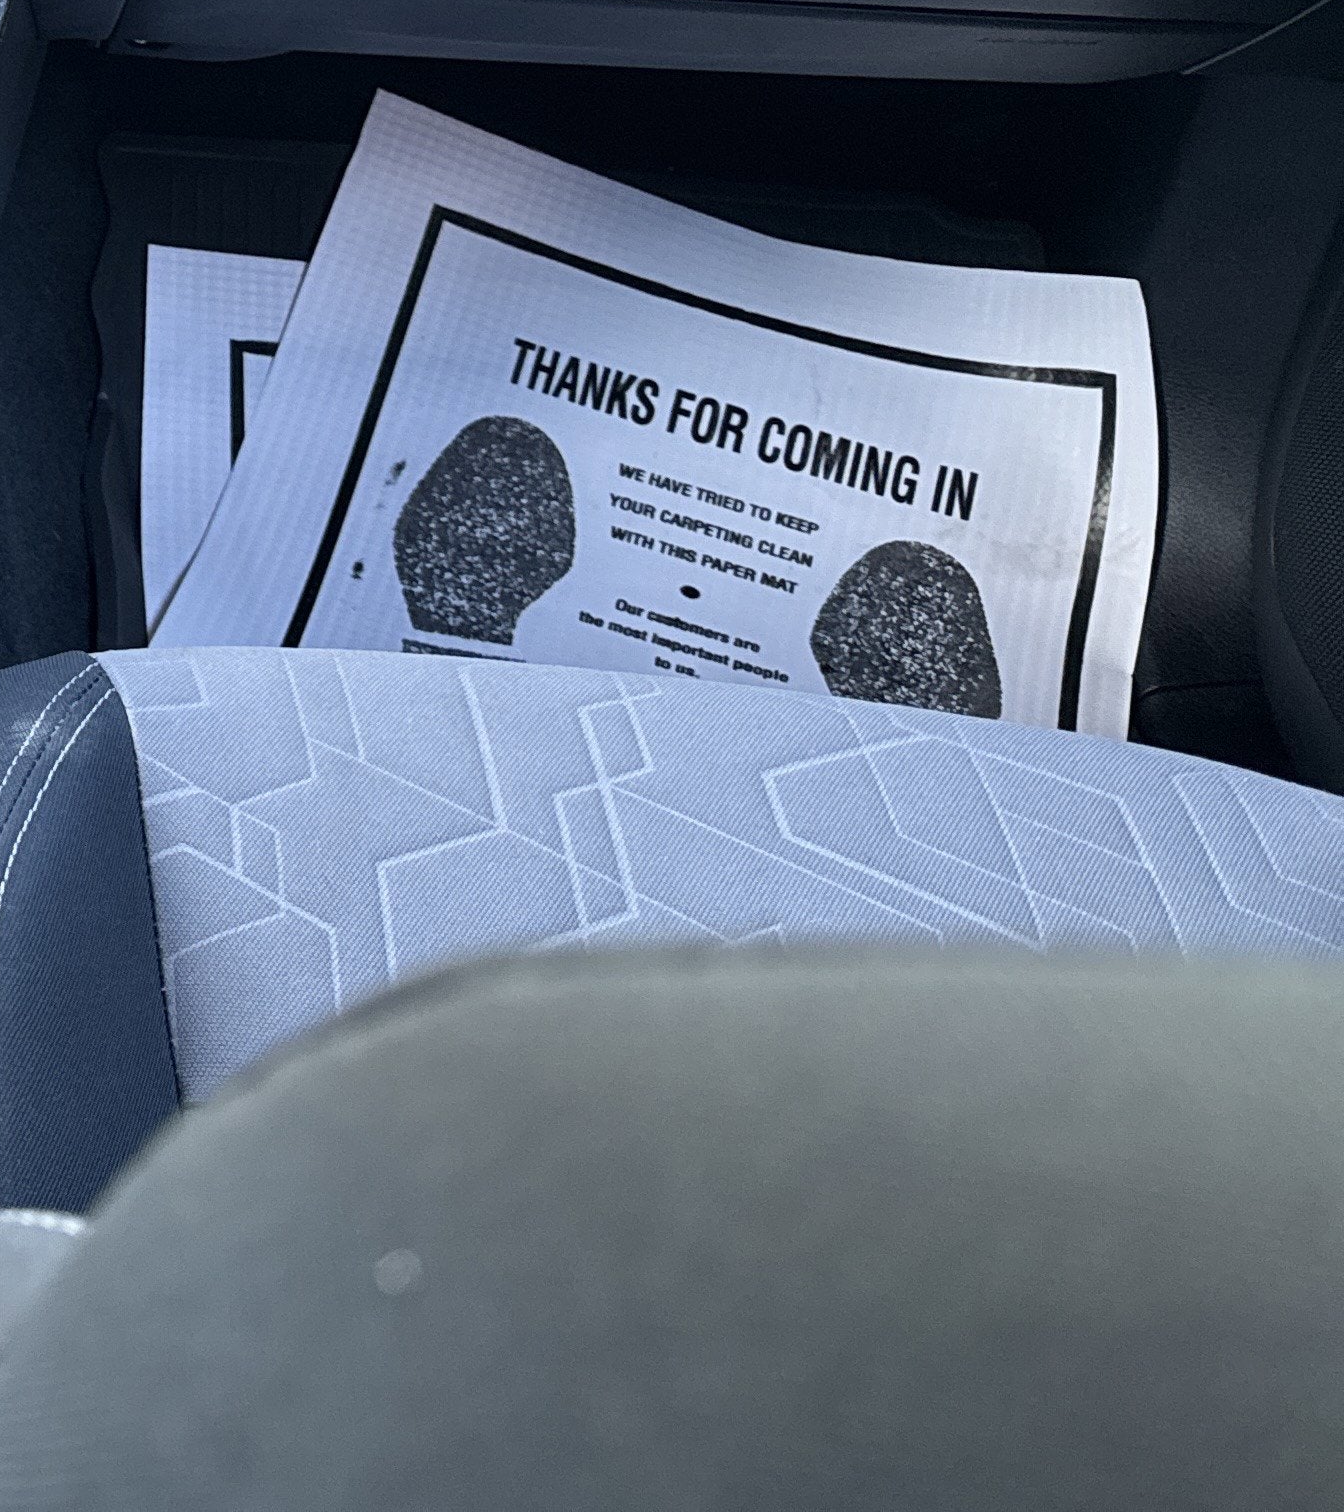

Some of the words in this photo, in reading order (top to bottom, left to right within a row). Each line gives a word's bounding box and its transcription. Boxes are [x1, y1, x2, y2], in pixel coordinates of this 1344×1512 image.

[510, 337, 660, 426] THANKS
[667, 389, 750, 453] FOR
[758, 416, 921, 506] COMING
[930, 465, 979, 522] IN
[610, 492, 657, 519] YOUR
[659, 510, 754, 549] CARPETING
[758, 540, 814, 567] CLEAN
[618, 462, 646, 483] WE
[648, 472, 693, 497] HAVE
[696, 486, 745, 514] TRIED
[749, 503, 773, 522] TO
[775, 511, 820, 535] KEEP
[611, 525, 655, 550] WITH
[658, 540, 698, 563] THIS
[700, 554, 756, 582] PAPER
[760, 572, 799, 594] MAT
[578, 610, 604, 627] the
[608, 622, 648, 641] most
[651, 633, 730, 666] important
[732, 660, 790, 683] people
[615, 598, 645, 617] Our
[647, 610, 730, 644] customers
[733, 637, 761, 653] are
[654, 656, 671, 670] to
[675, 664, 701, 680] us.
